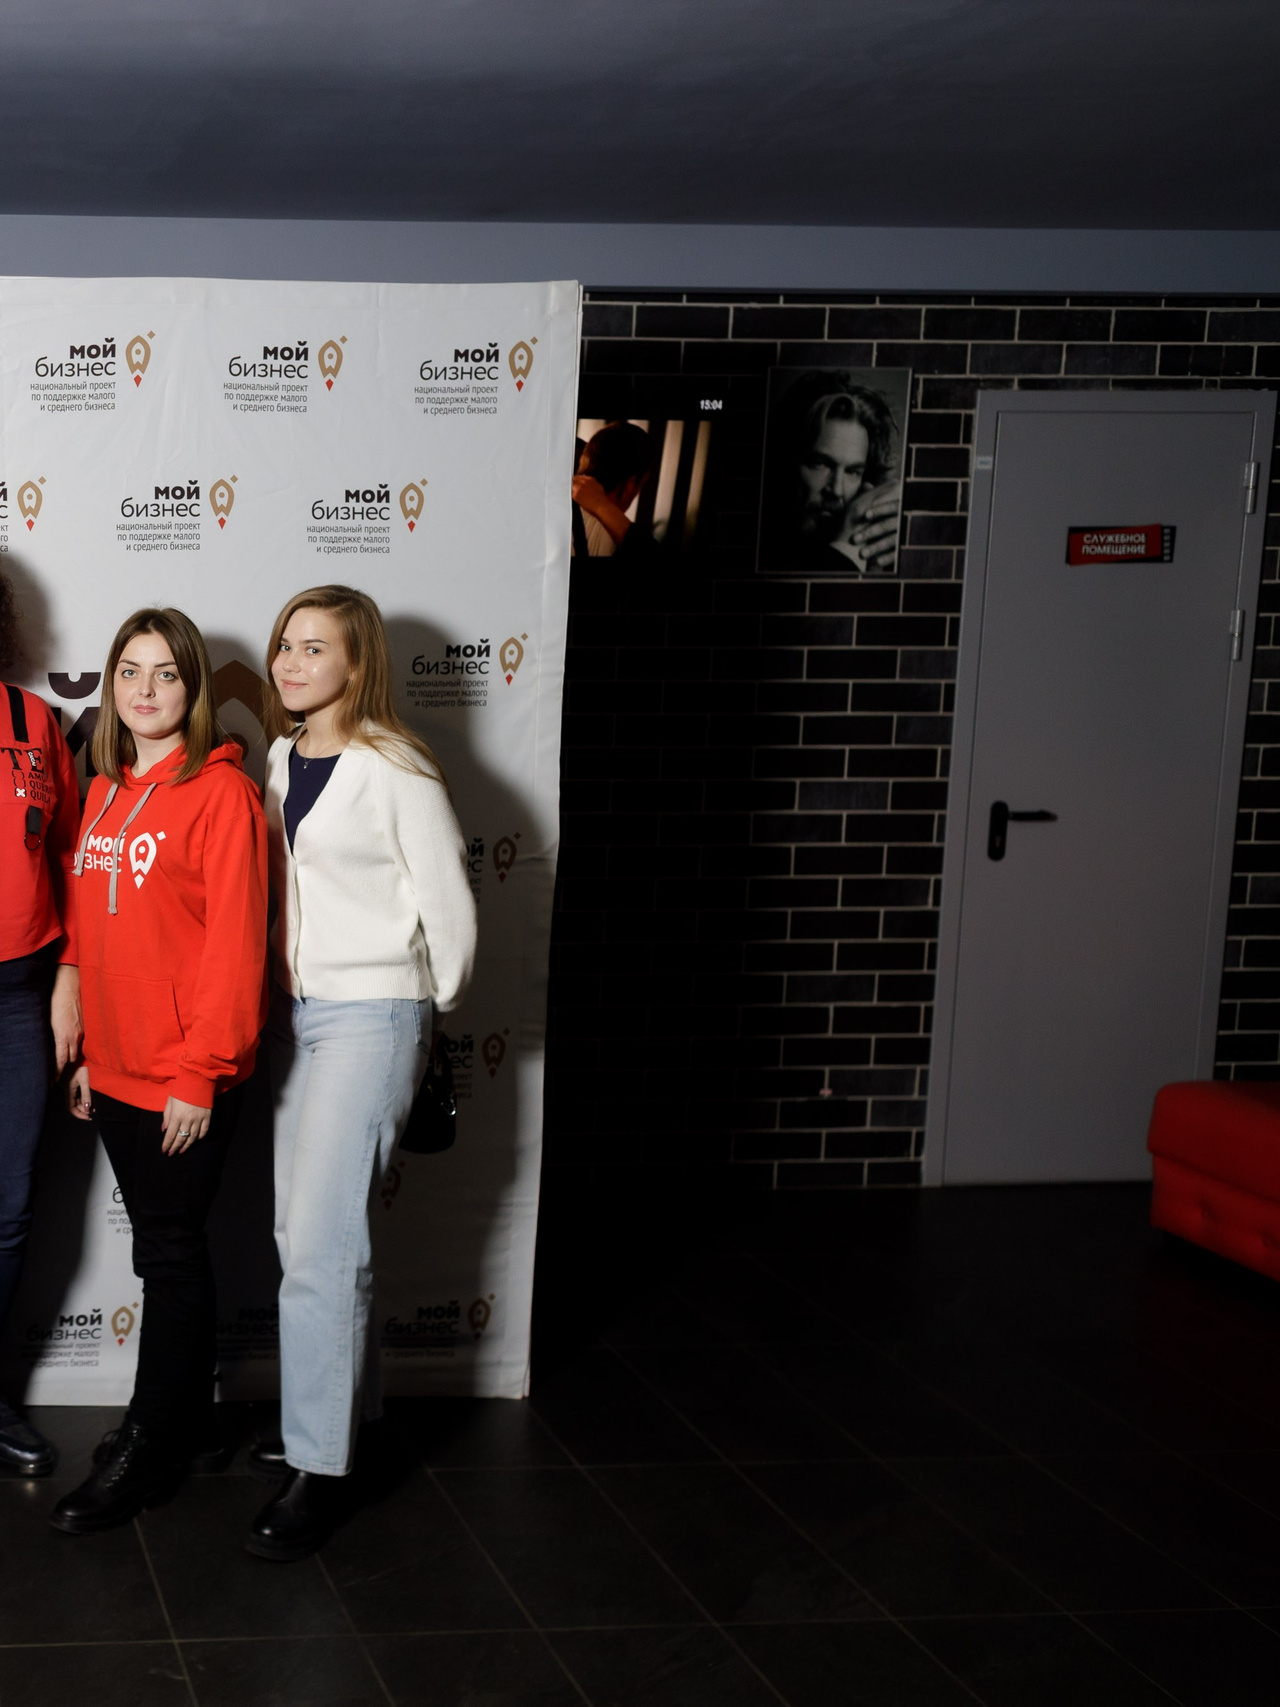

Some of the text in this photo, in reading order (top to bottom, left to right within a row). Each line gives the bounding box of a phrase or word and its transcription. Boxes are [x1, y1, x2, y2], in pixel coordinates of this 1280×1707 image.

[68, 338, 117, 359] мой
[262, 340, 310, 361] мой
[453, 342, 500, 363] мой
[35, 355, 117, 378] бизнес
[228, 356, 309, 379] бизнес
[419, 359, 500, 381] бизнес
[30, 381, 116, 393] национальный проект
[223, 382, 308, 394] национальный проект
[414, 385, 499, 396] национальный проект
[31, 392, 116, 403] по поддержке малого
[224, 392, 308, 403] по поддержке малого
[415, 396, 498, 406] по поддержке малого
[47, 403, 83, 412] среднего
[84, 401, 116, 410] бизнеса
[239, 403, 275, 413] среднего
[276, 403, 307, 412] бизнеса
[430, 406, 466, 415] среднего
[466, 405, 497, 414] бизнеса
[153, 480, 201, 500] мой
[344, 483, 391, 503] мой
[120, 496, 201, 518] бизнес
[311, 500, 391, 521] бизнес
[116, 522, 201, 532] национальный проект
[306, 525, 391, 535] национальный проект
[129, 532, 172, 542] поддержке
[173, 532, 201, 540] малого
[319, 535, 362, 545] поддержке
[1083, 533, 1146, 544] СЛУЖЕБНОЕ
[133, 542, 169, 552] среднего
[170, 541, 201, 550] бизнеса
[323, 545, 359, 554] среднего
[360, 544, 390, 553] бизнеса
[1082, 544, 1146, 555] ПОМЕЩЕНИЕ
[411, 654, 490, 675] бизнес
[60, 1308, 102, 1327] мой
[27, 1323, 103, 1342] бизнес
